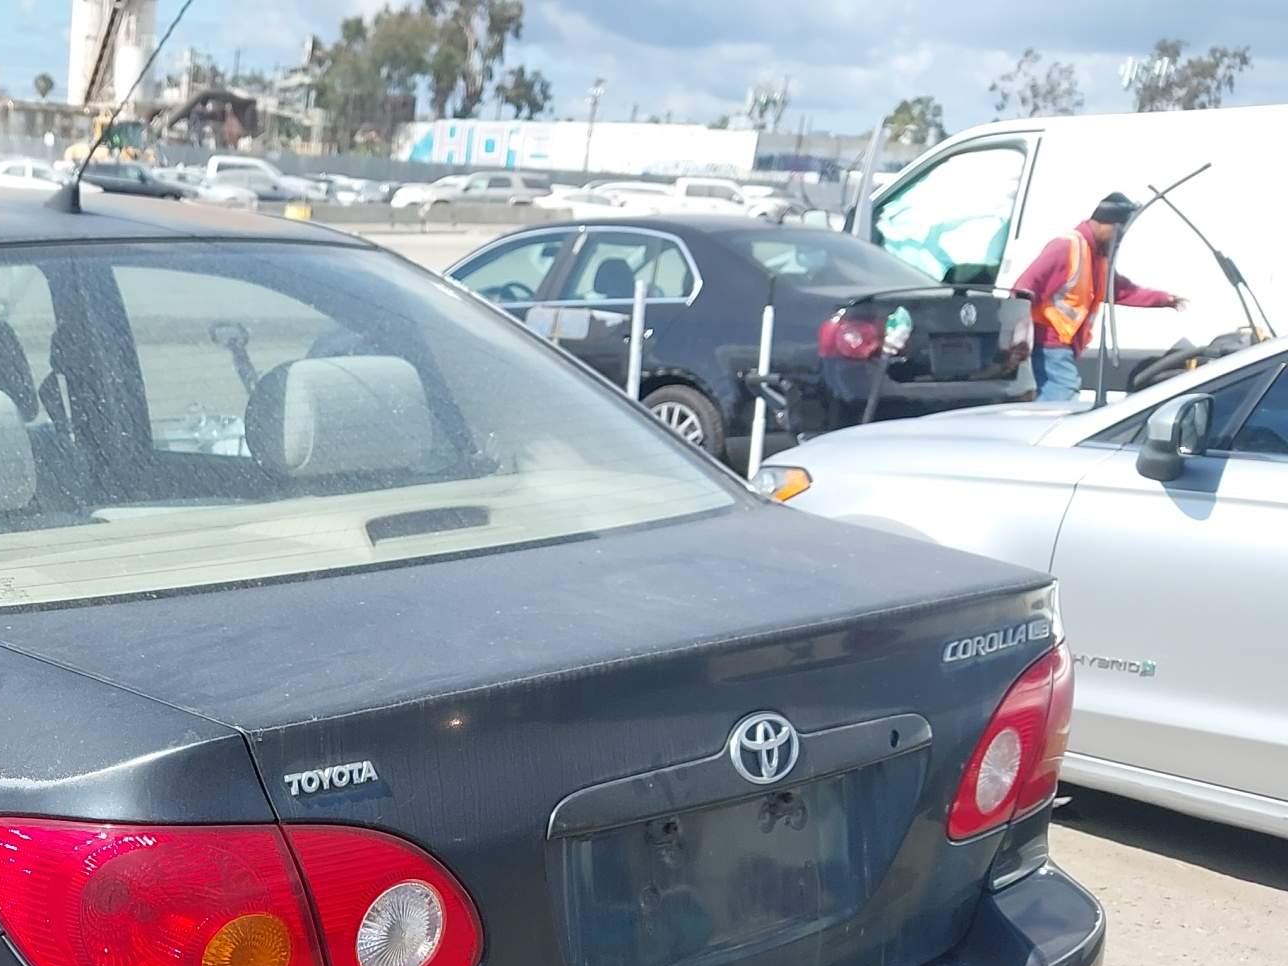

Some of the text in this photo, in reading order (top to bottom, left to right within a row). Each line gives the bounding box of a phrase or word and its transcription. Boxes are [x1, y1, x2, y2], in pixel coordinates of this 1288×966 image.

[943, 623, 1026, 663] COROLLA
[1072, 655, 1140, 674] HYBRID
[284, 760, 378, 796] TOYOTA
